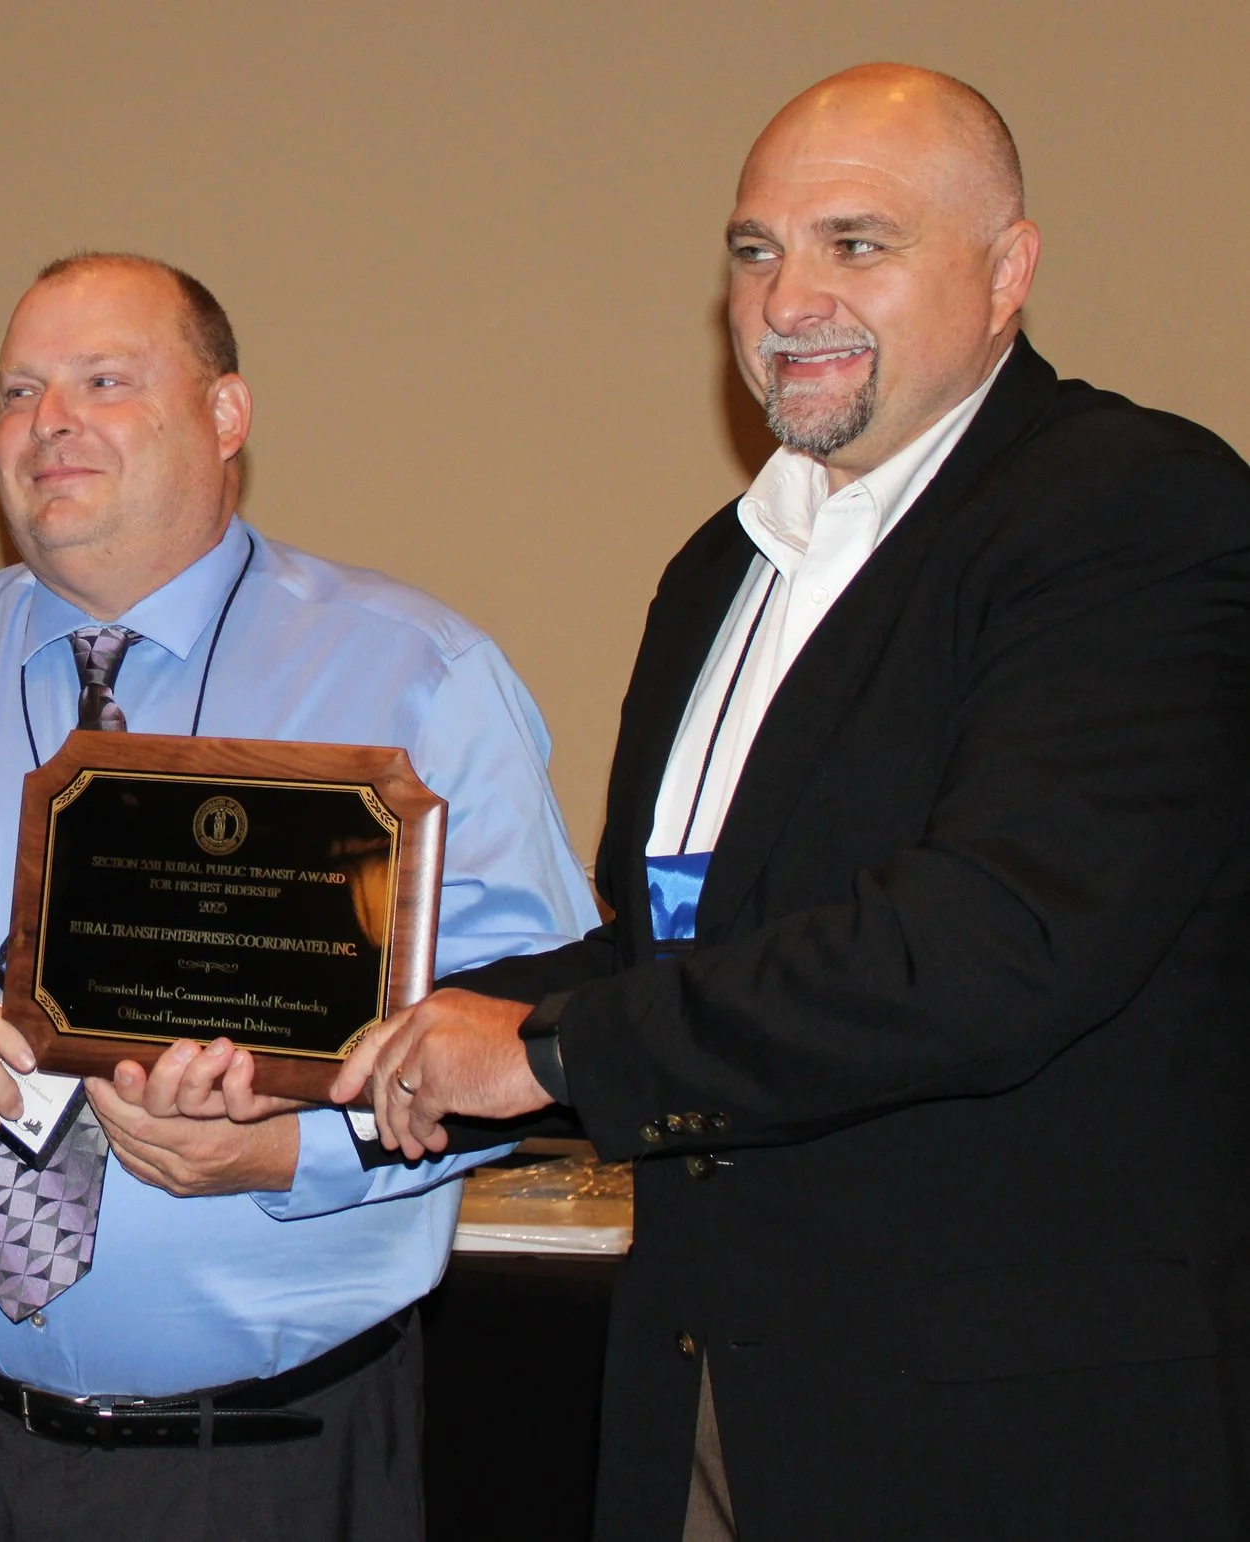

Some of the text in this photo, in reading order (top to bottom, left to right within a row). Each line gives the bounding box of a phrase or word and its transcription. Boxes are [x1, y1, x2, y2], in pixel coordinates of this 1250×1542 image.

[92, 856, 137, 869] SECTION
[165, 861, 203, 873] RURAL
[206, 864, 246, 877] PUBLIC
[250, 867, 295, 881] TRANSIT
[298, 871, 346, 884] AWARD
[150, 878, 282, 898] FOR HIGHEST RIDERSHIP
[199, 901, 227, 914] 2025
[70, 920, 111, 936] RURAL
[112, 924, 161, 940] TRANSIT
[161, 929, 234, 946] ENTERPRISES
[236, 933, 331, 956] COORDINATED,
[88, 979, 328, 1015] Presented by the Commonwealth of Kentucky
[118, 1005, 291, 1037] Office of Transportation Delivery
